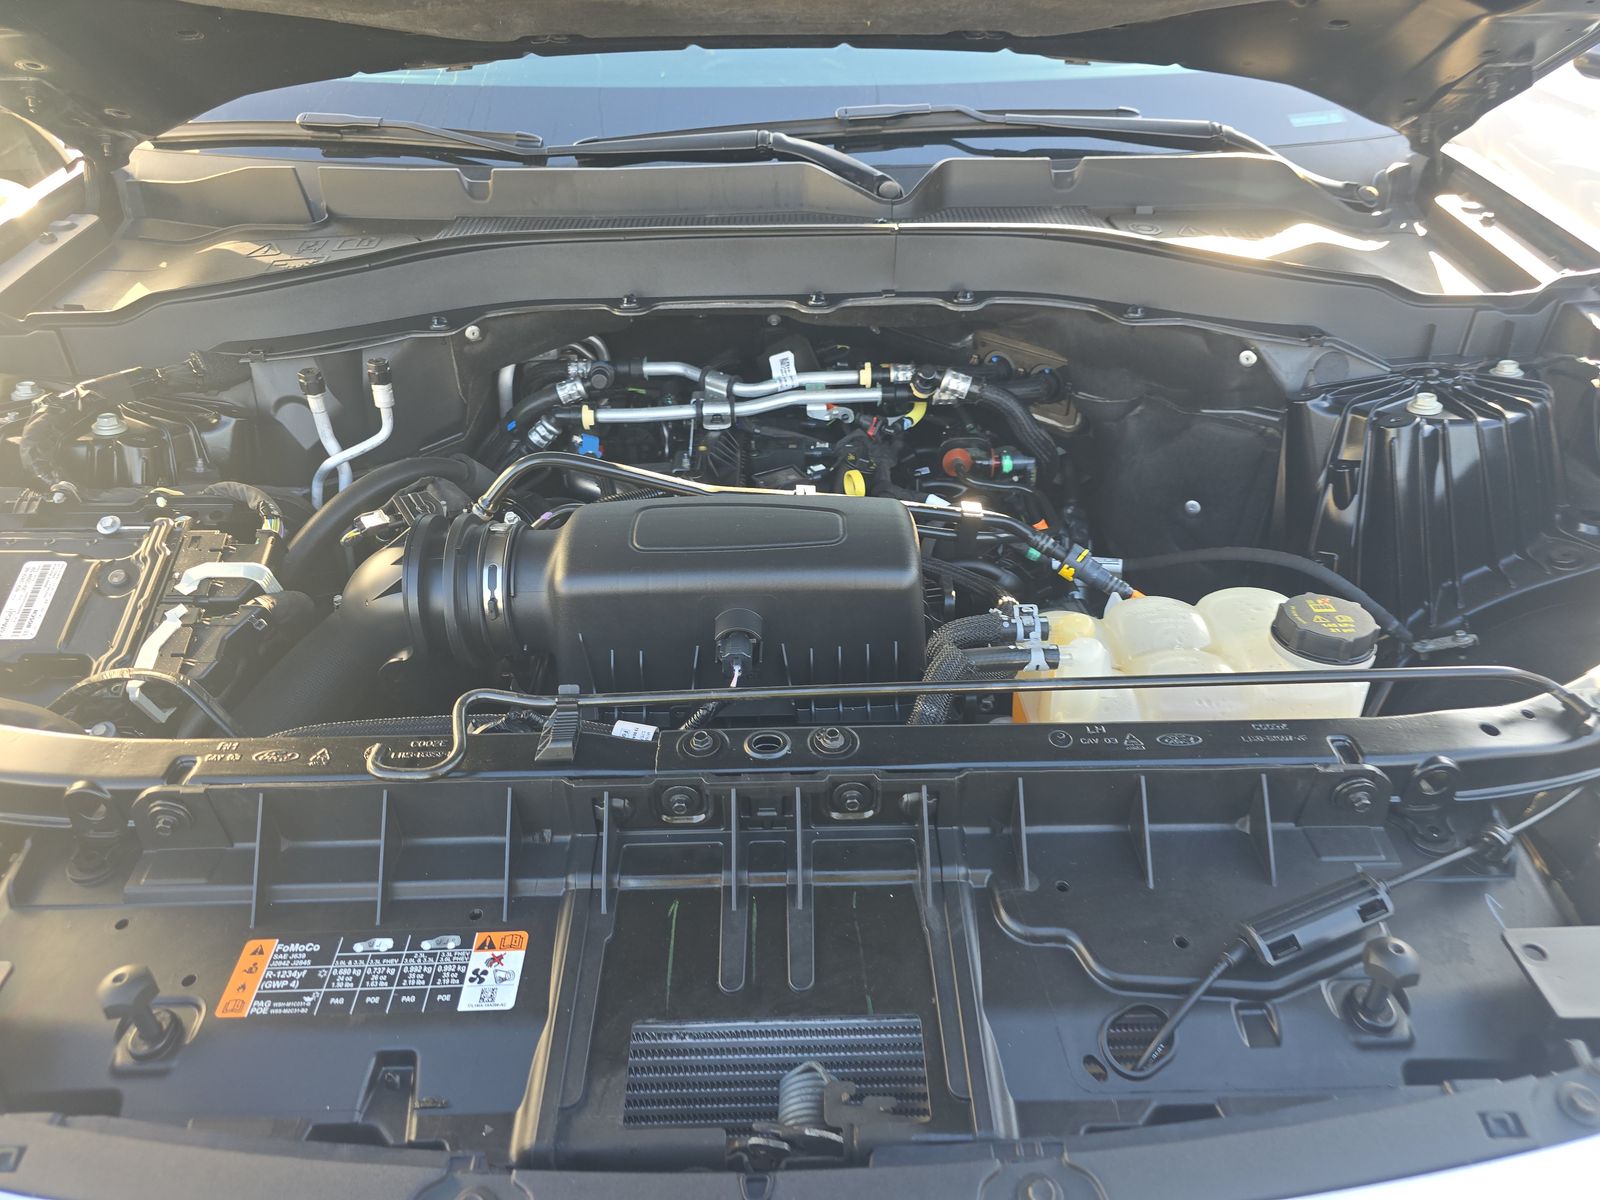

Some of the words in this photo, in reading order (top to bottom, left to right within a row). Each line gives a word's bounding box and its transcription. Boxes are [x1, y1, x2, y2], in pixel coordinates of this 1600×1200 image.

[1085, 725, 1107, 734] LH
[276, 943, 320, 952] FoMoCo
[332, 968, 352, 976] 0.680
[352, 968, 362, 977] kg
[367, 967, 386, 975] 0.737
[386, 967, 396, 976] kg
[403, 965, 423, 974] 0.992
[423, 965, 432, 974] kg
[437, 965, 457, 973] 0.992
[457, 964, 467, 973] kg
[265, 970, 307, 979] R-1234yf
[261, 980, 288, 990] (GWP
[289, 980, 299, 989] 4)
[330, 997, 345, 1005] PAG
[365, 996, 380, 1004] POE
[401, 995, 416, 1003] PAG
[437, 994, 451, 1002] POE
[250, 1007, 268, 1015] POE
